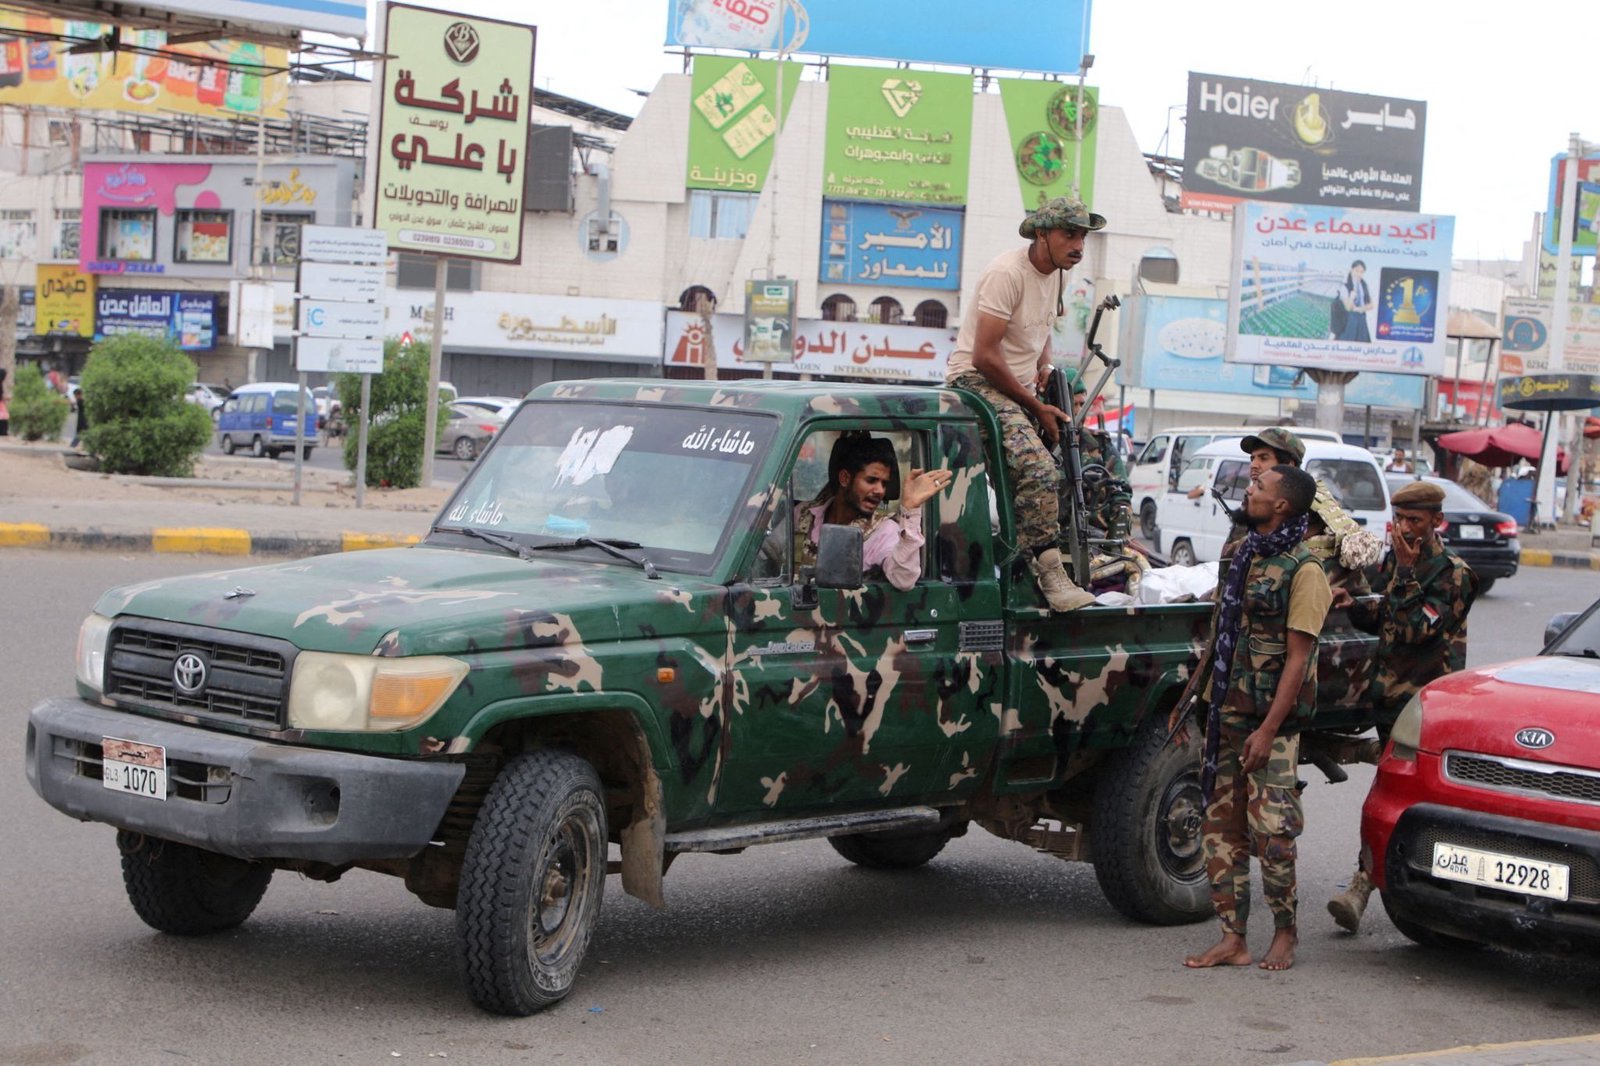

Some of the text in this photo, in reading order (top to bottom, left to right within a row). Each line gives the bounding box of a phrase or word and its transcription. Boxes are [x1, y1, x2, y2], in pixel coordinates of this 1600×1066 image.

[394, 69, 519, 124] شركة
[1200, 81, 1280, 121] Haier
[1341, 103, 1417, 132] هاير
[391, 133, 486, 171] علي
[384, 183, 518, 215] للصرافة والتحويلات
[1256, 214, 1436, 244] أكيد سماء عدن
[99, 294, 127, 316] عدن
[129, 294, 171, 317] العاقل
[852, 334, 936, 363] عدن
[793, 362, 822, 371] ADEN
[834, 364, 913, 377] INTERNATIONAL
[1521, 731, 1546, 746] KIA
[123, 765, 157, 795] 1070
[1494, 861, 1550, 891] 12928
